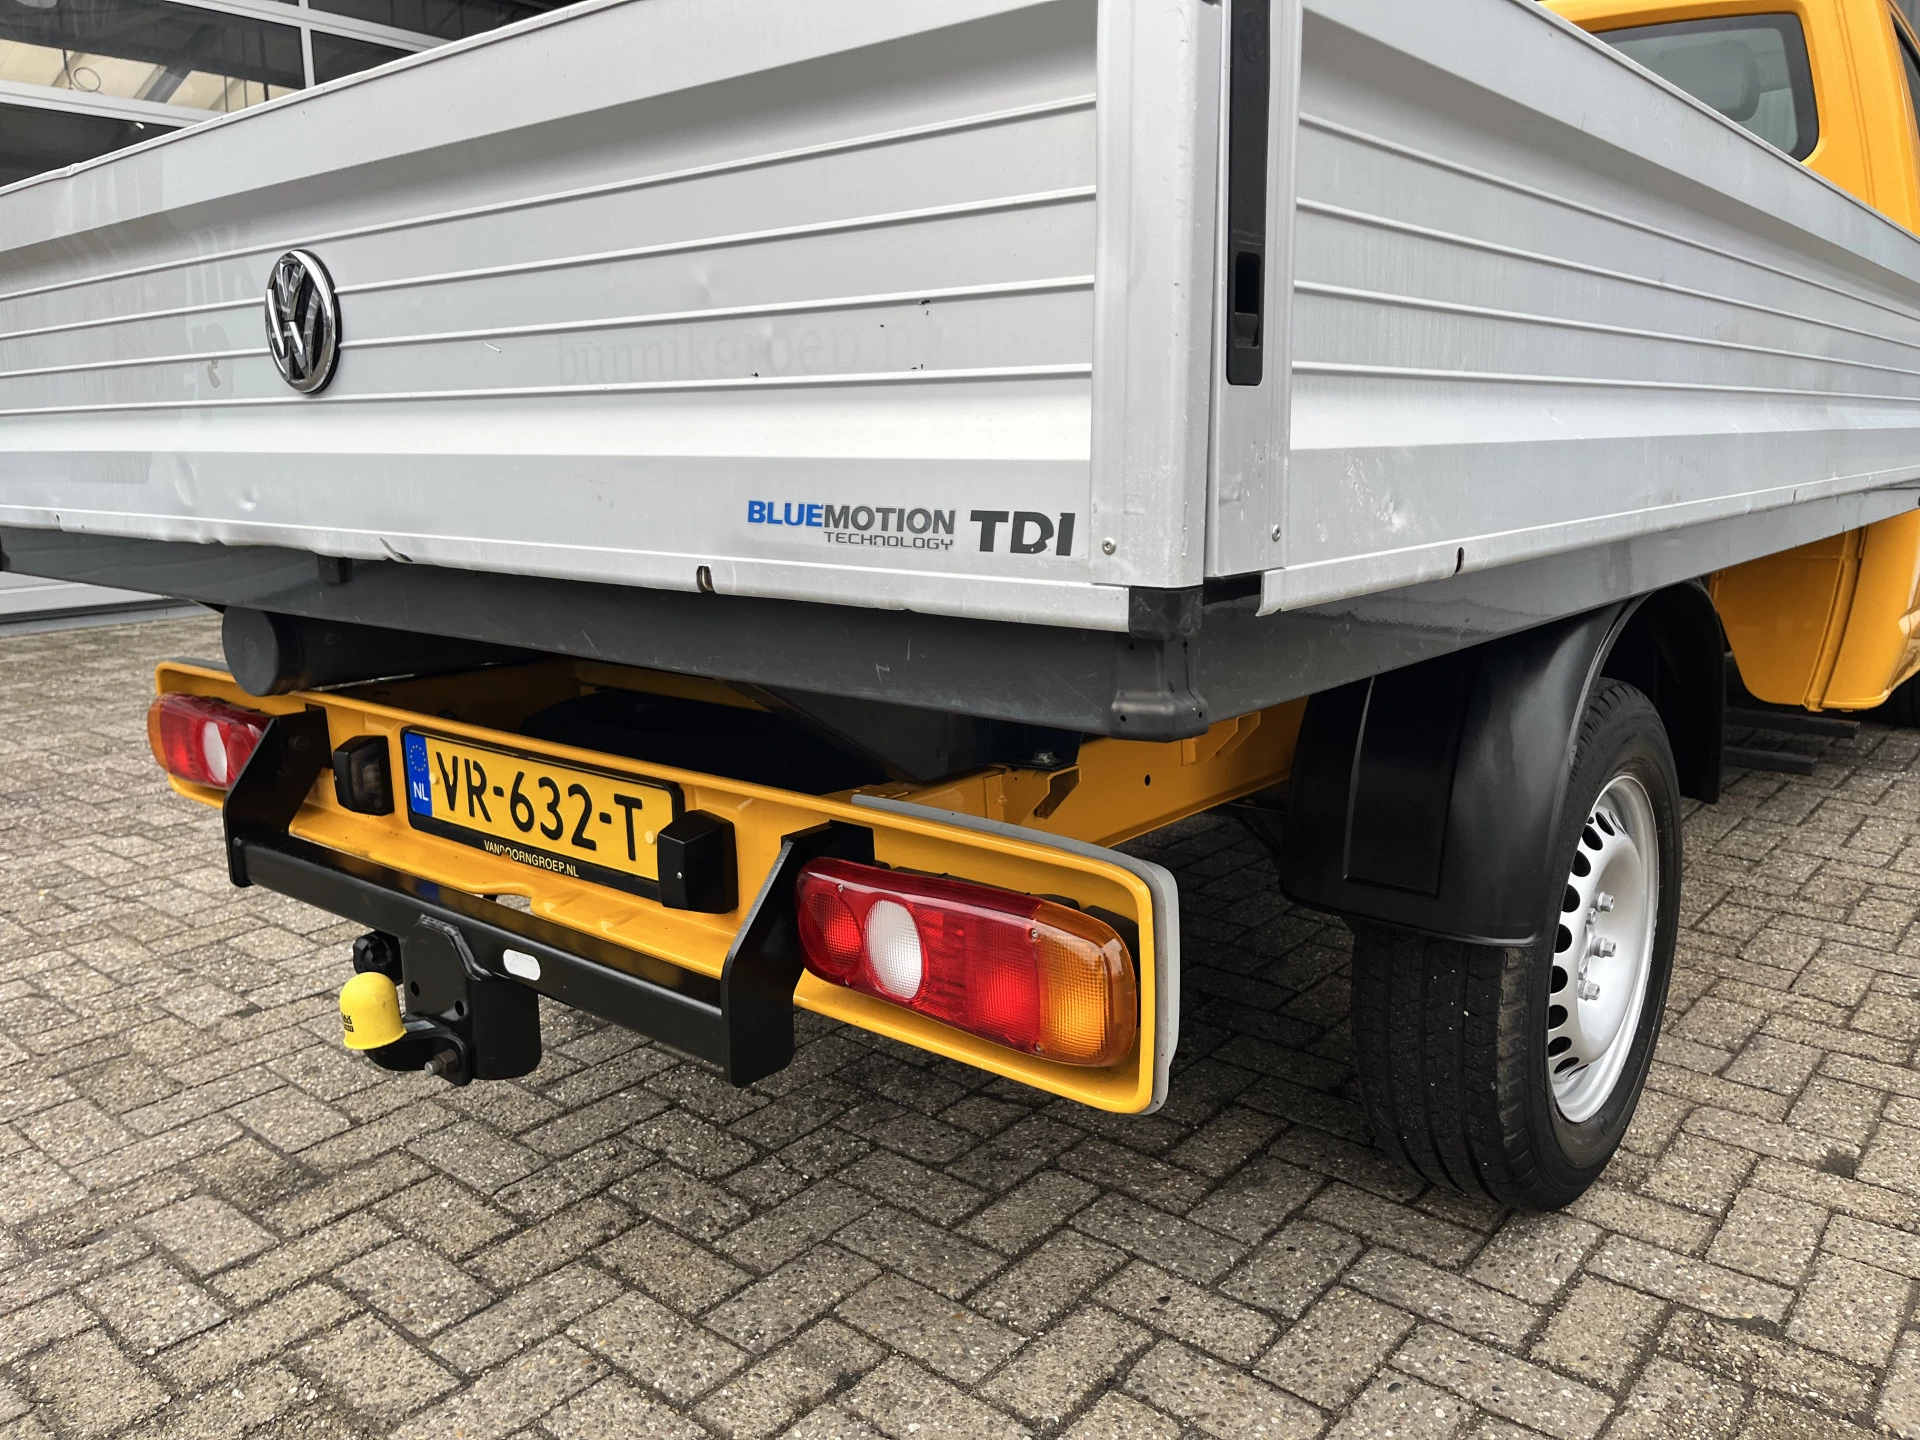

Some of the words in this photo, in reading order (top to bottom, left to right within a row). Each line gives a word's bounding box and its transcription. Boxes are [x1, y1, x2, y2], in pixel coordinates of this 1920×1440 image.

[747, 500, 956, 534] BLUEMOTION
[970, 510, 1076, 556] TDI
[824, 531, 954, 550] TECHNOLOGY
[413, 781, 429, 802] NL
[436, 751, 643, 862] VR-632-T
